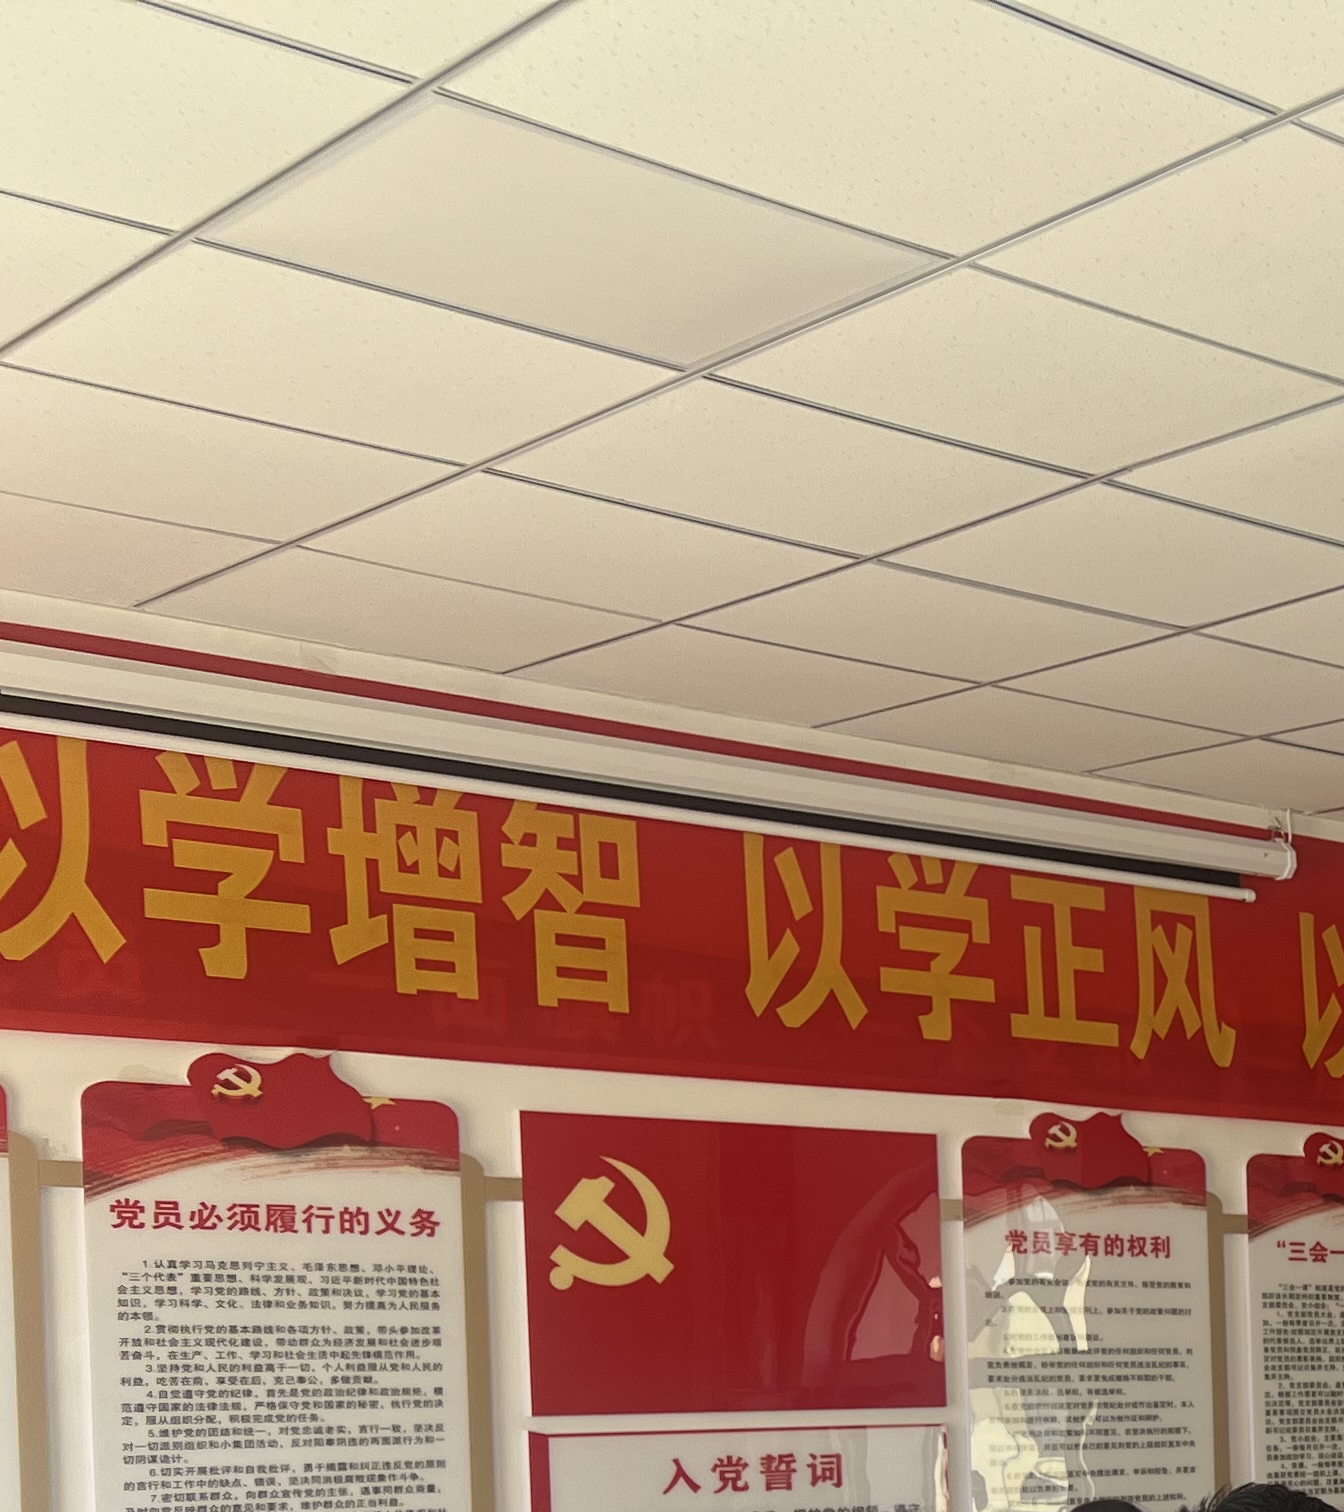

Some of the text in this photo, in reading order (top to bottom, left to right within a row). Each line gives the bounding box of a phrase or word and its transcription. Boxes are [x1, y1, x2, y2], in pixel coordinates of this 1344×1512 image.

[0, 735, 641, 1014] 以学增智
[743, 832, 1237, 1068] 以学正风
[109, 1197, 441, 1238] 党员必须履行的义务
[1005, 1229, 1171, 1259] 党员享有的权利
[663, 1452, 844, 1495] 入党誓词
